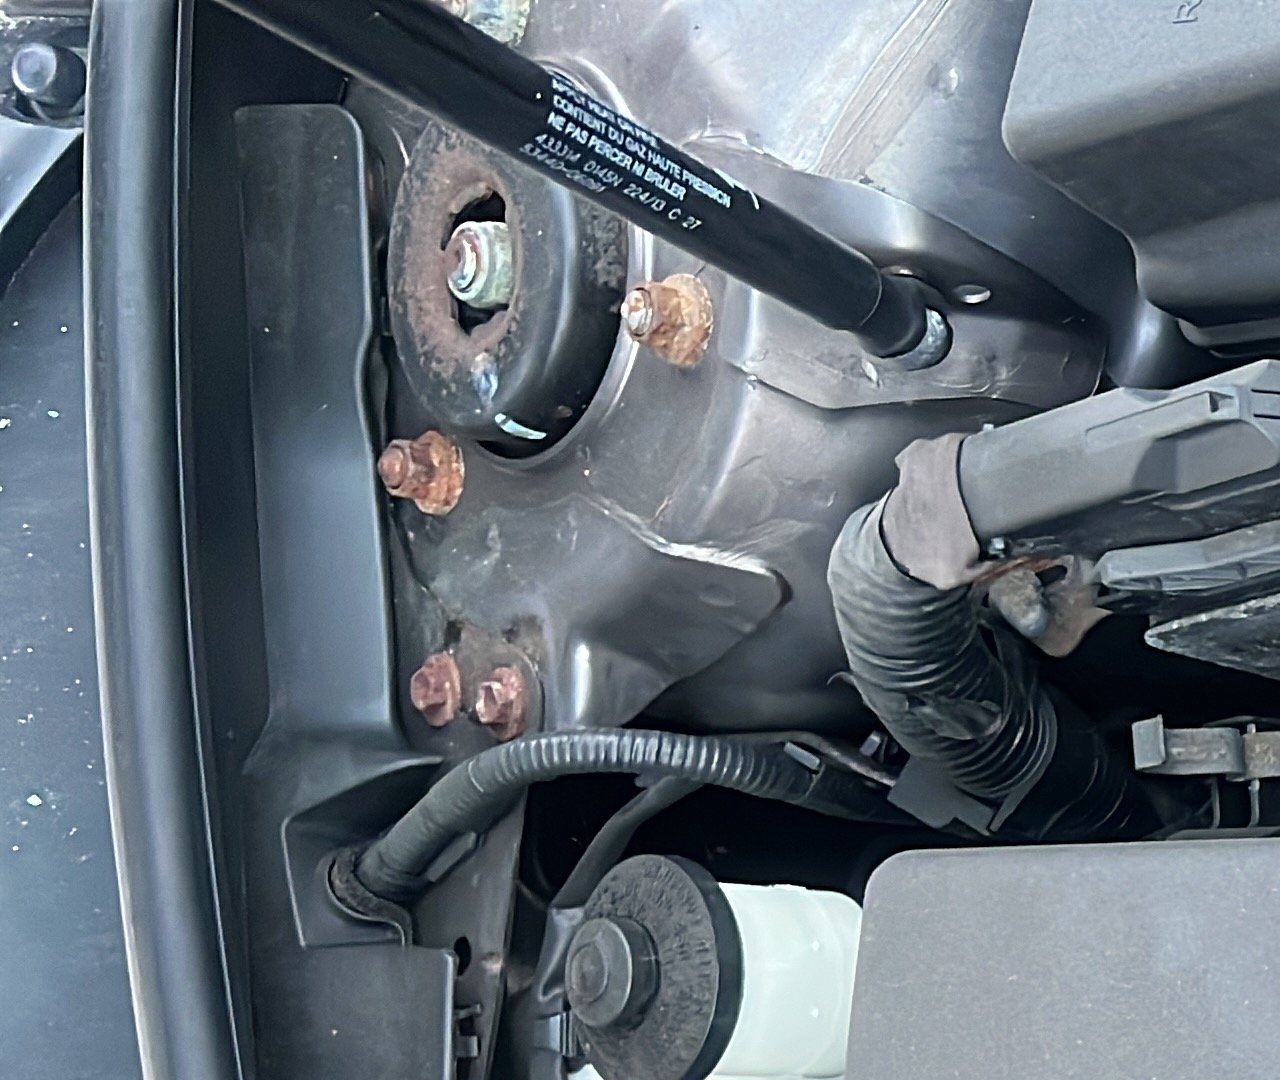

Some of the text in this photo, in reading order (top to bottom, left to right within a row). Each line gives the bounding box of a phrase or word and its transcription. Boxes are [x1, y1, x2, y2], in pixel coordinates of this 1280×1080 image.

[547, 112, 566, 132] NE
[565, 121, 588, 145] PAS
[588, 134, 633, 170] PERCER
[608, 127, 625, 145] DU
[625, 135, 646, 159] GAZ
[647, 148, 683, 179] HAUTE
[668, 207, 682, 221] C
